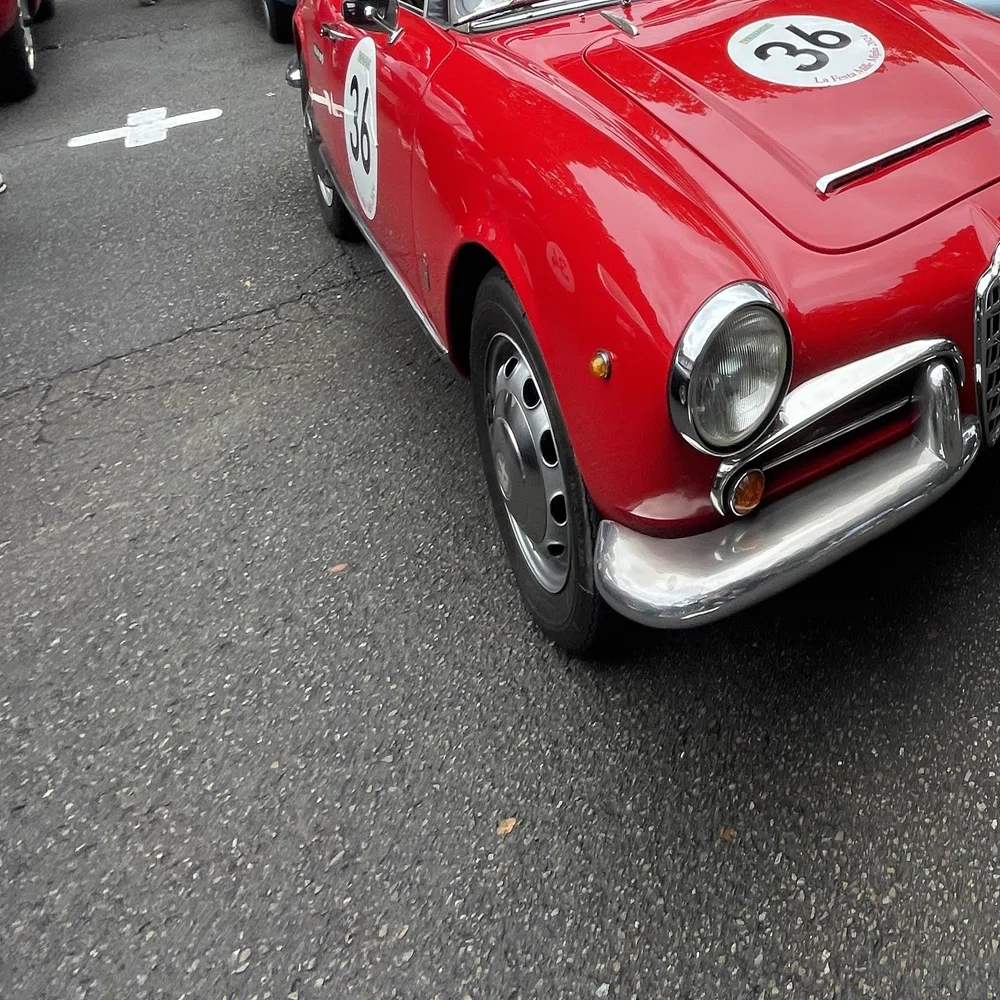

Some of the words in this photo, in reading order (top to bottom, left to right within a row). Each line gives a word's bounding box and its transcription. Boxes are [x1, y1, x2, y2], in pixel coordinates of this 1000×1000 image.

[753, 23, 852, 72] 36
[814, 76, 830, 84] La
[830, 72, 857, 82] Festa
[349, 74, 371, 175] 36
